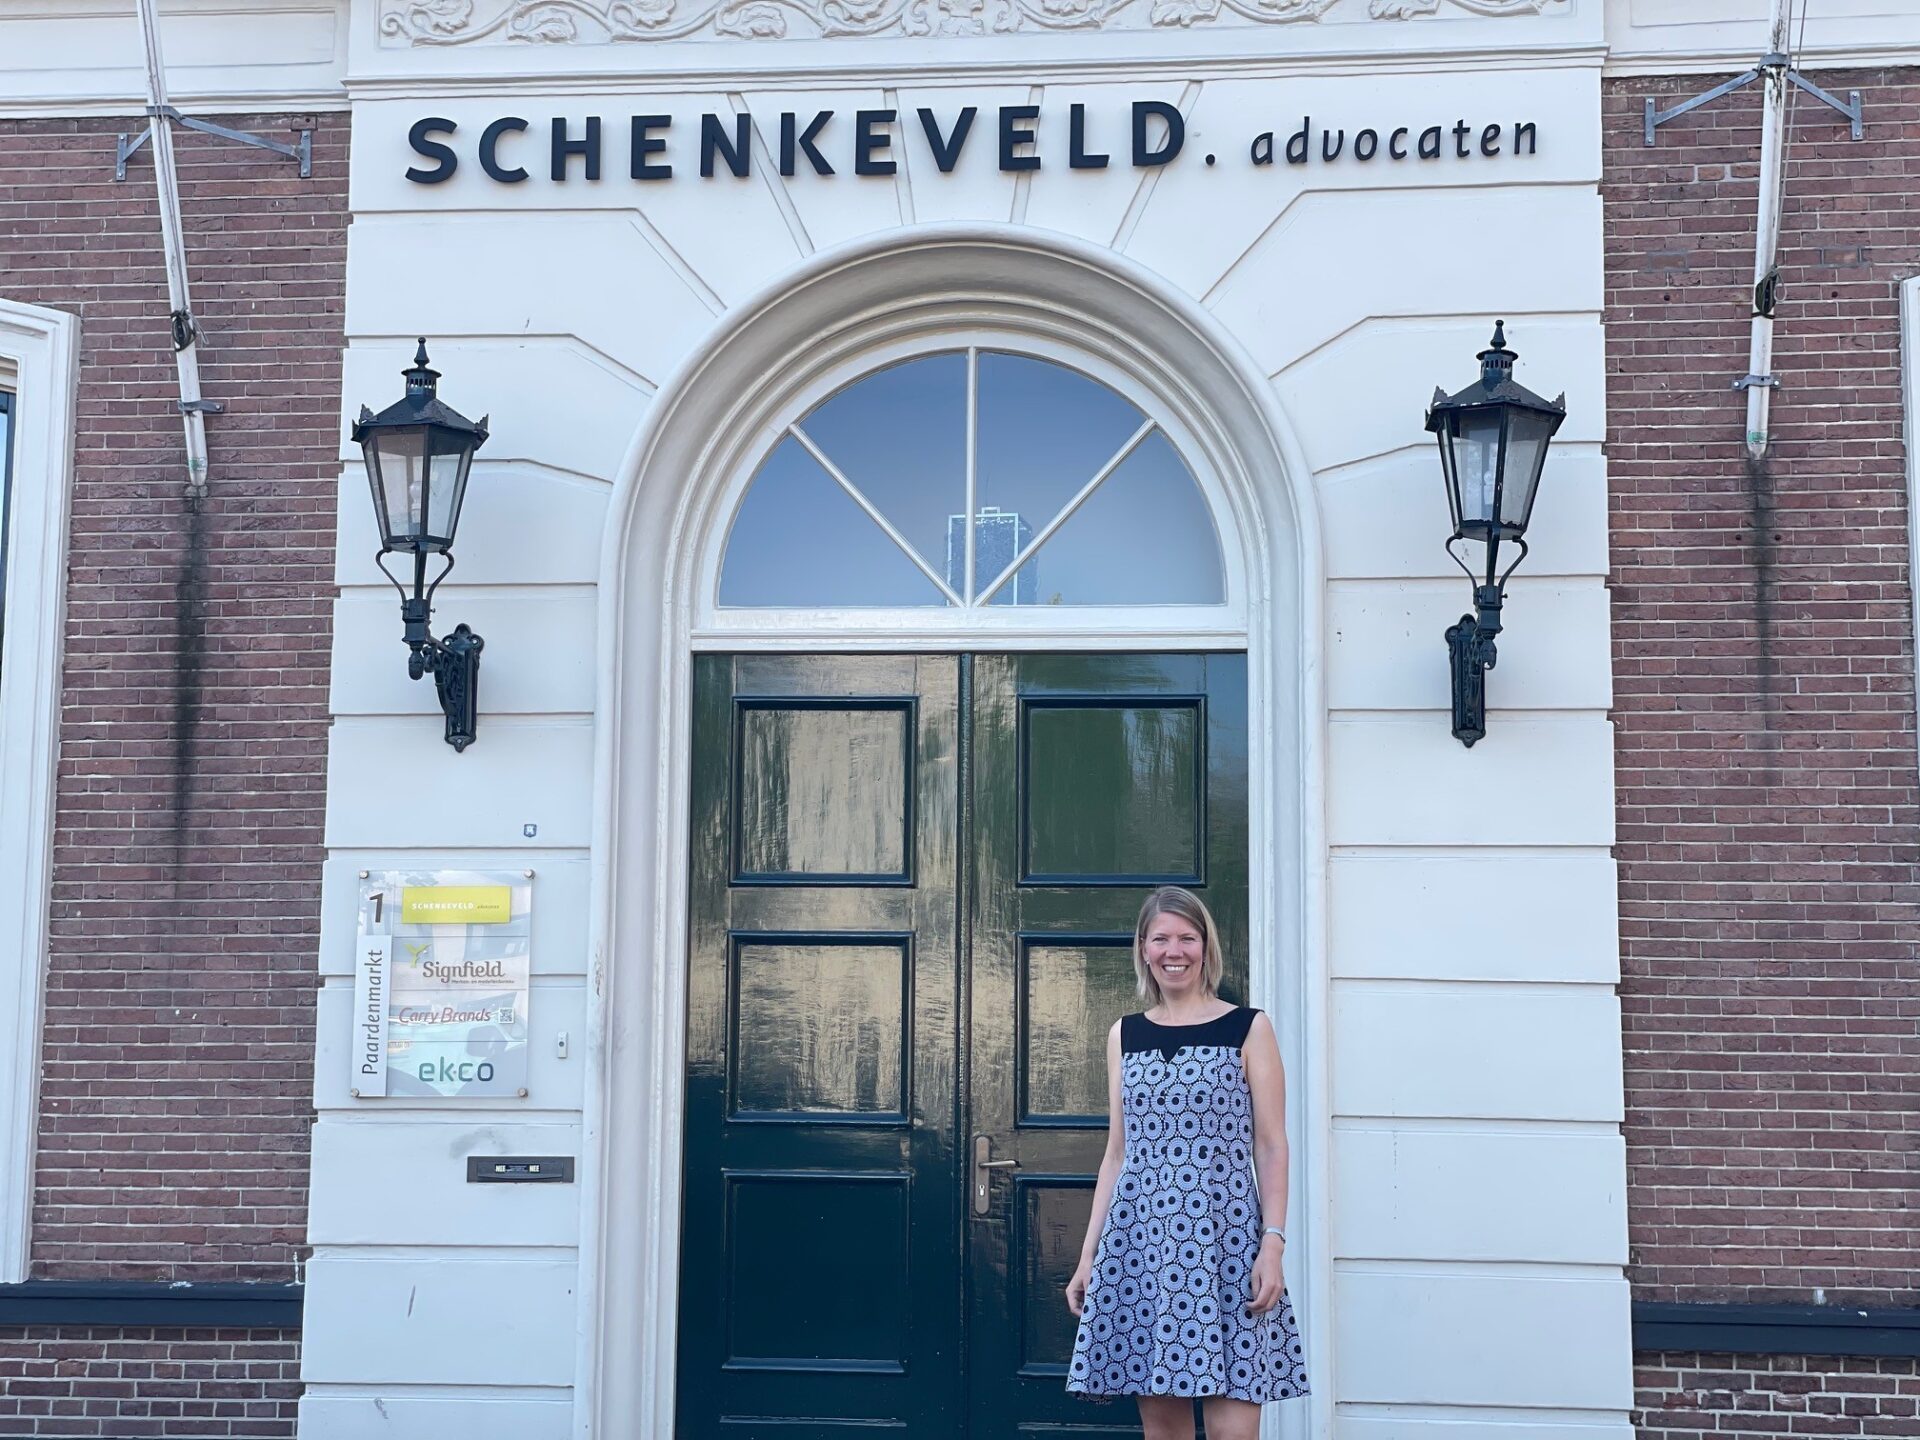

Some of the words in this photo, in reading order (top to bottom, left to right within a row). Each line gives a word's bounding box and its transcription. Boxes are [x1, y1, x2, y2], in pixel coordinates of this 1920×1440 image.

[1249, 115, 1537, 166] advocaten
[368, 892, 384, 924] 1
[422, 960, 507, 984] Signfield
[361, 949, 383, 1075] Paardenmarkt
[399, 1007, 439, 1025] Carry
[440, 1007, 491, 1023] Brands
